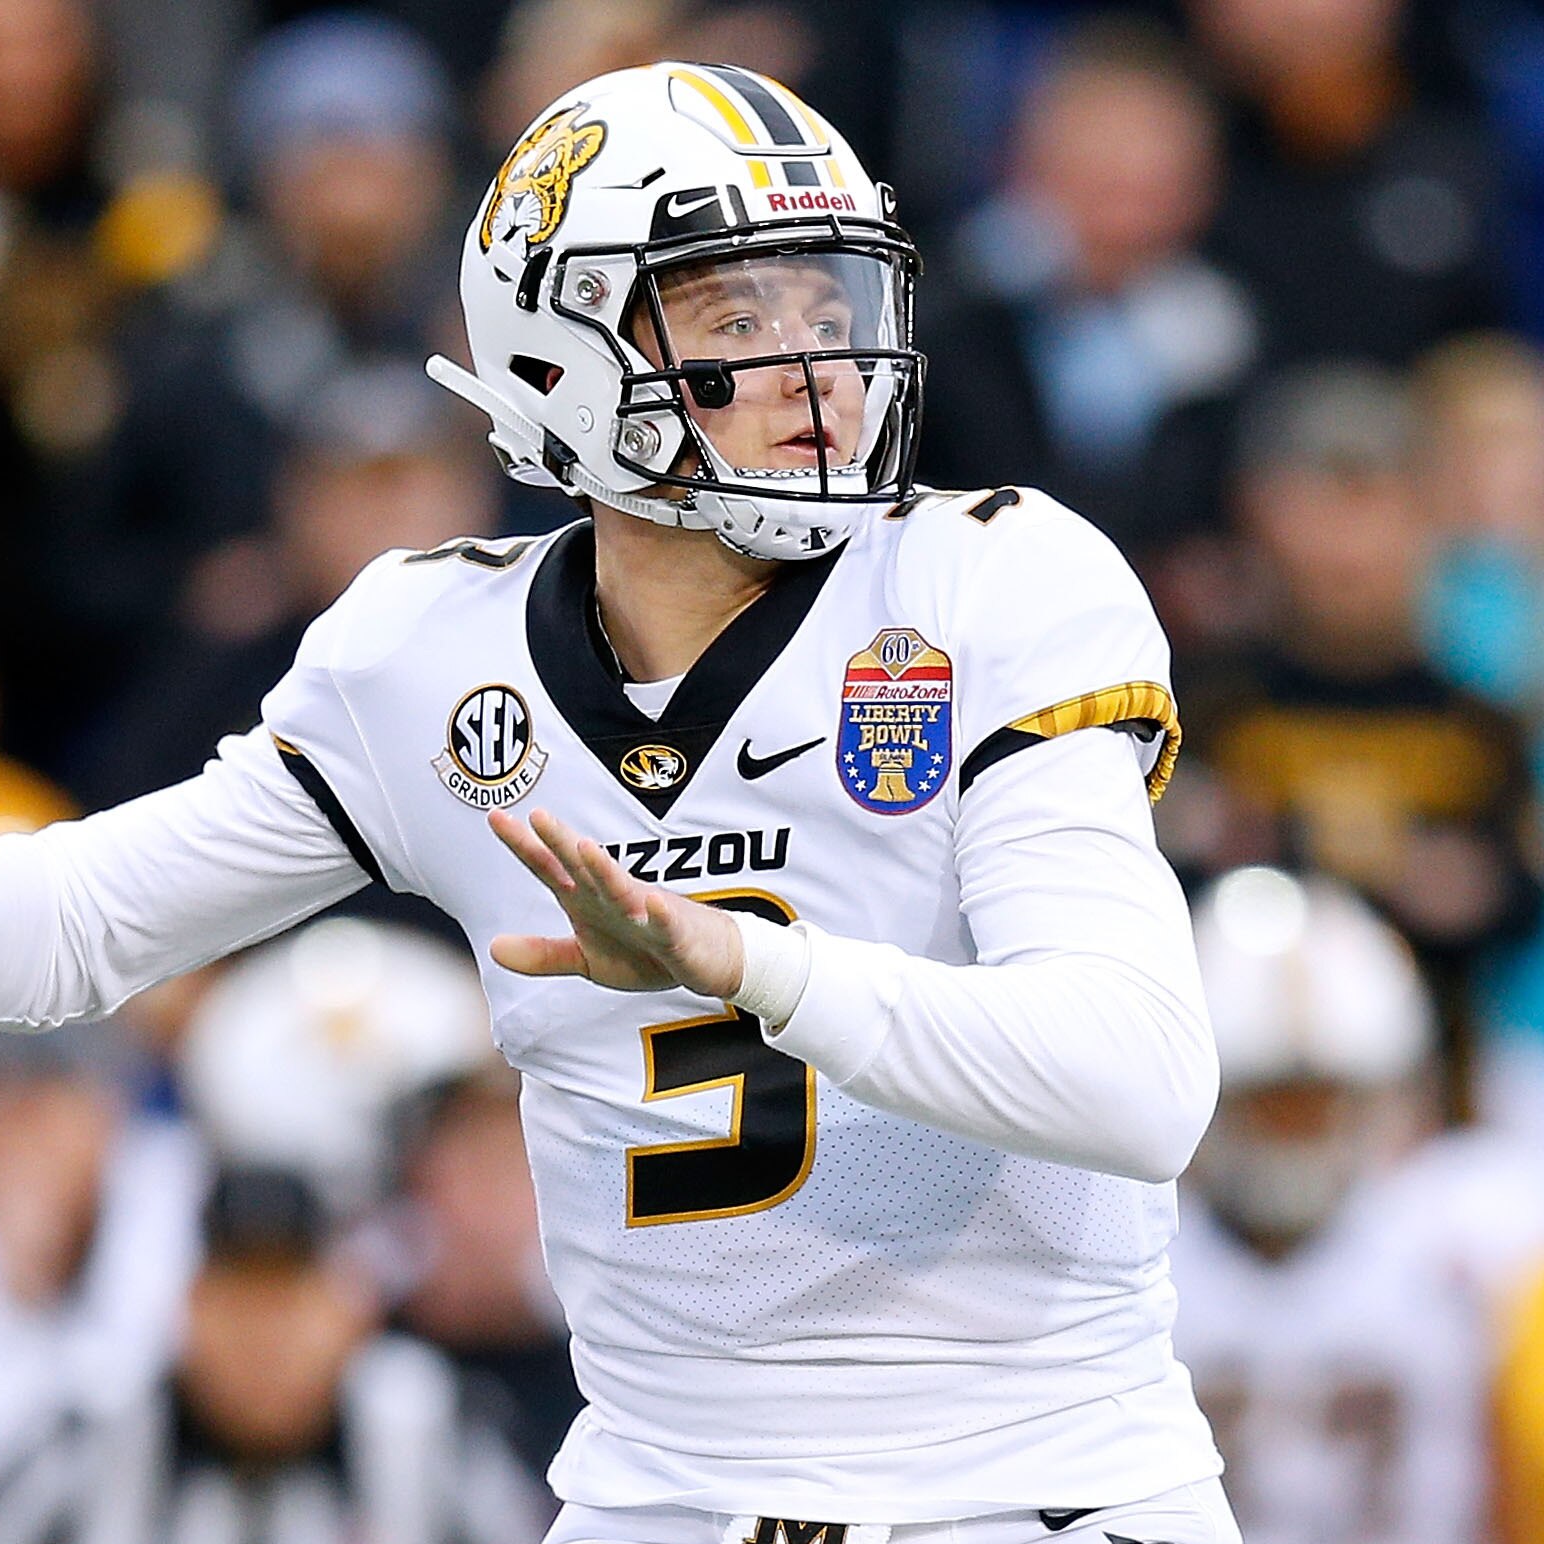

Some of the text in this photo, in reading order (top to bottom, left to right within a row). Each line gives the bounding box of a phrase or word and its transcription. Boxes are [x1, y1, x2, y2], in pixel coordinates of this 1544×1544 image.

[767, 191, 856, 212] Riddell
[875, 685, 948, 699] AutoZone
[849, 704, 941, 723] LIBERTY
[456, 690, 525, 777] SEC
[858, 724, 928, 751] BOWL
[448, 768, 533, 806] GRADUATE
[625, 886, 817, 1228] 3
